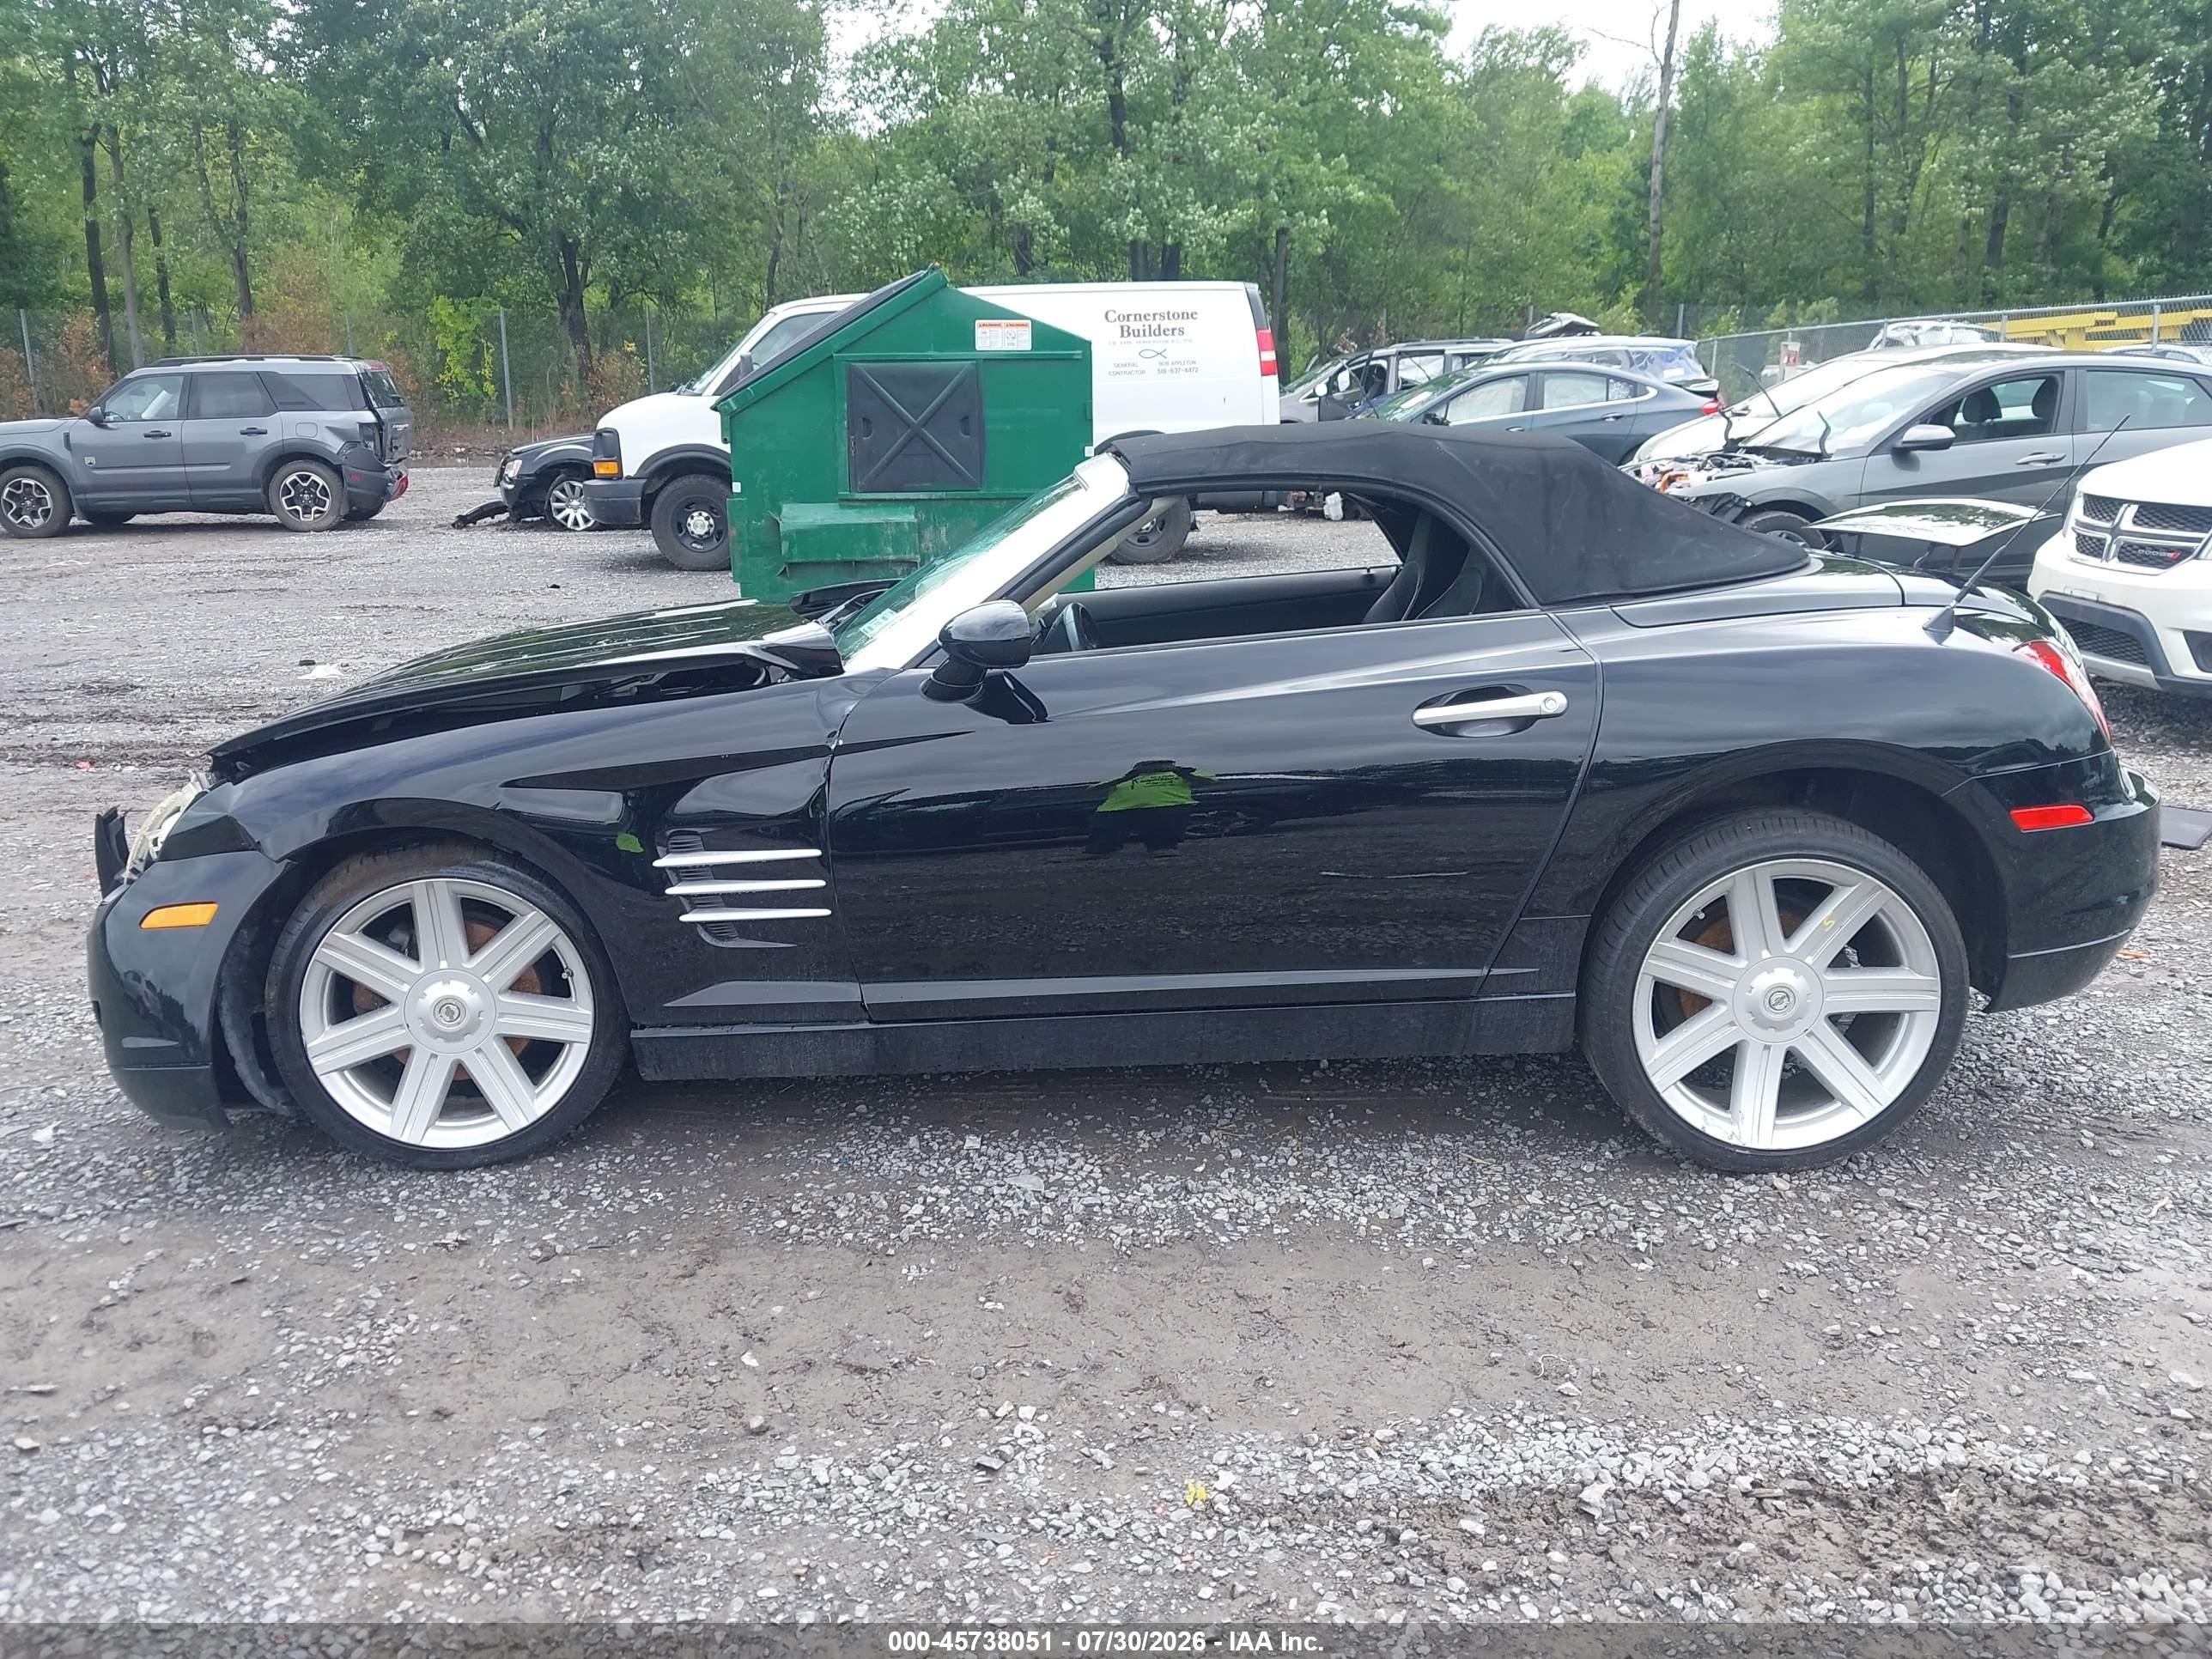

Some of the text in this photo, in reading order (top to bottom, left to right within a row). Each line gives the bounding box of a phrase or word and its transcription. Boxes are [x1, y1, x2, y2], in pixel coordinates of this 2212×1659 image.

[1104, 309, 1198, 323] Cornerstone
[1119, 323, 1185, 338] Builders
[2137, 549, 2172, 557] DODGE
